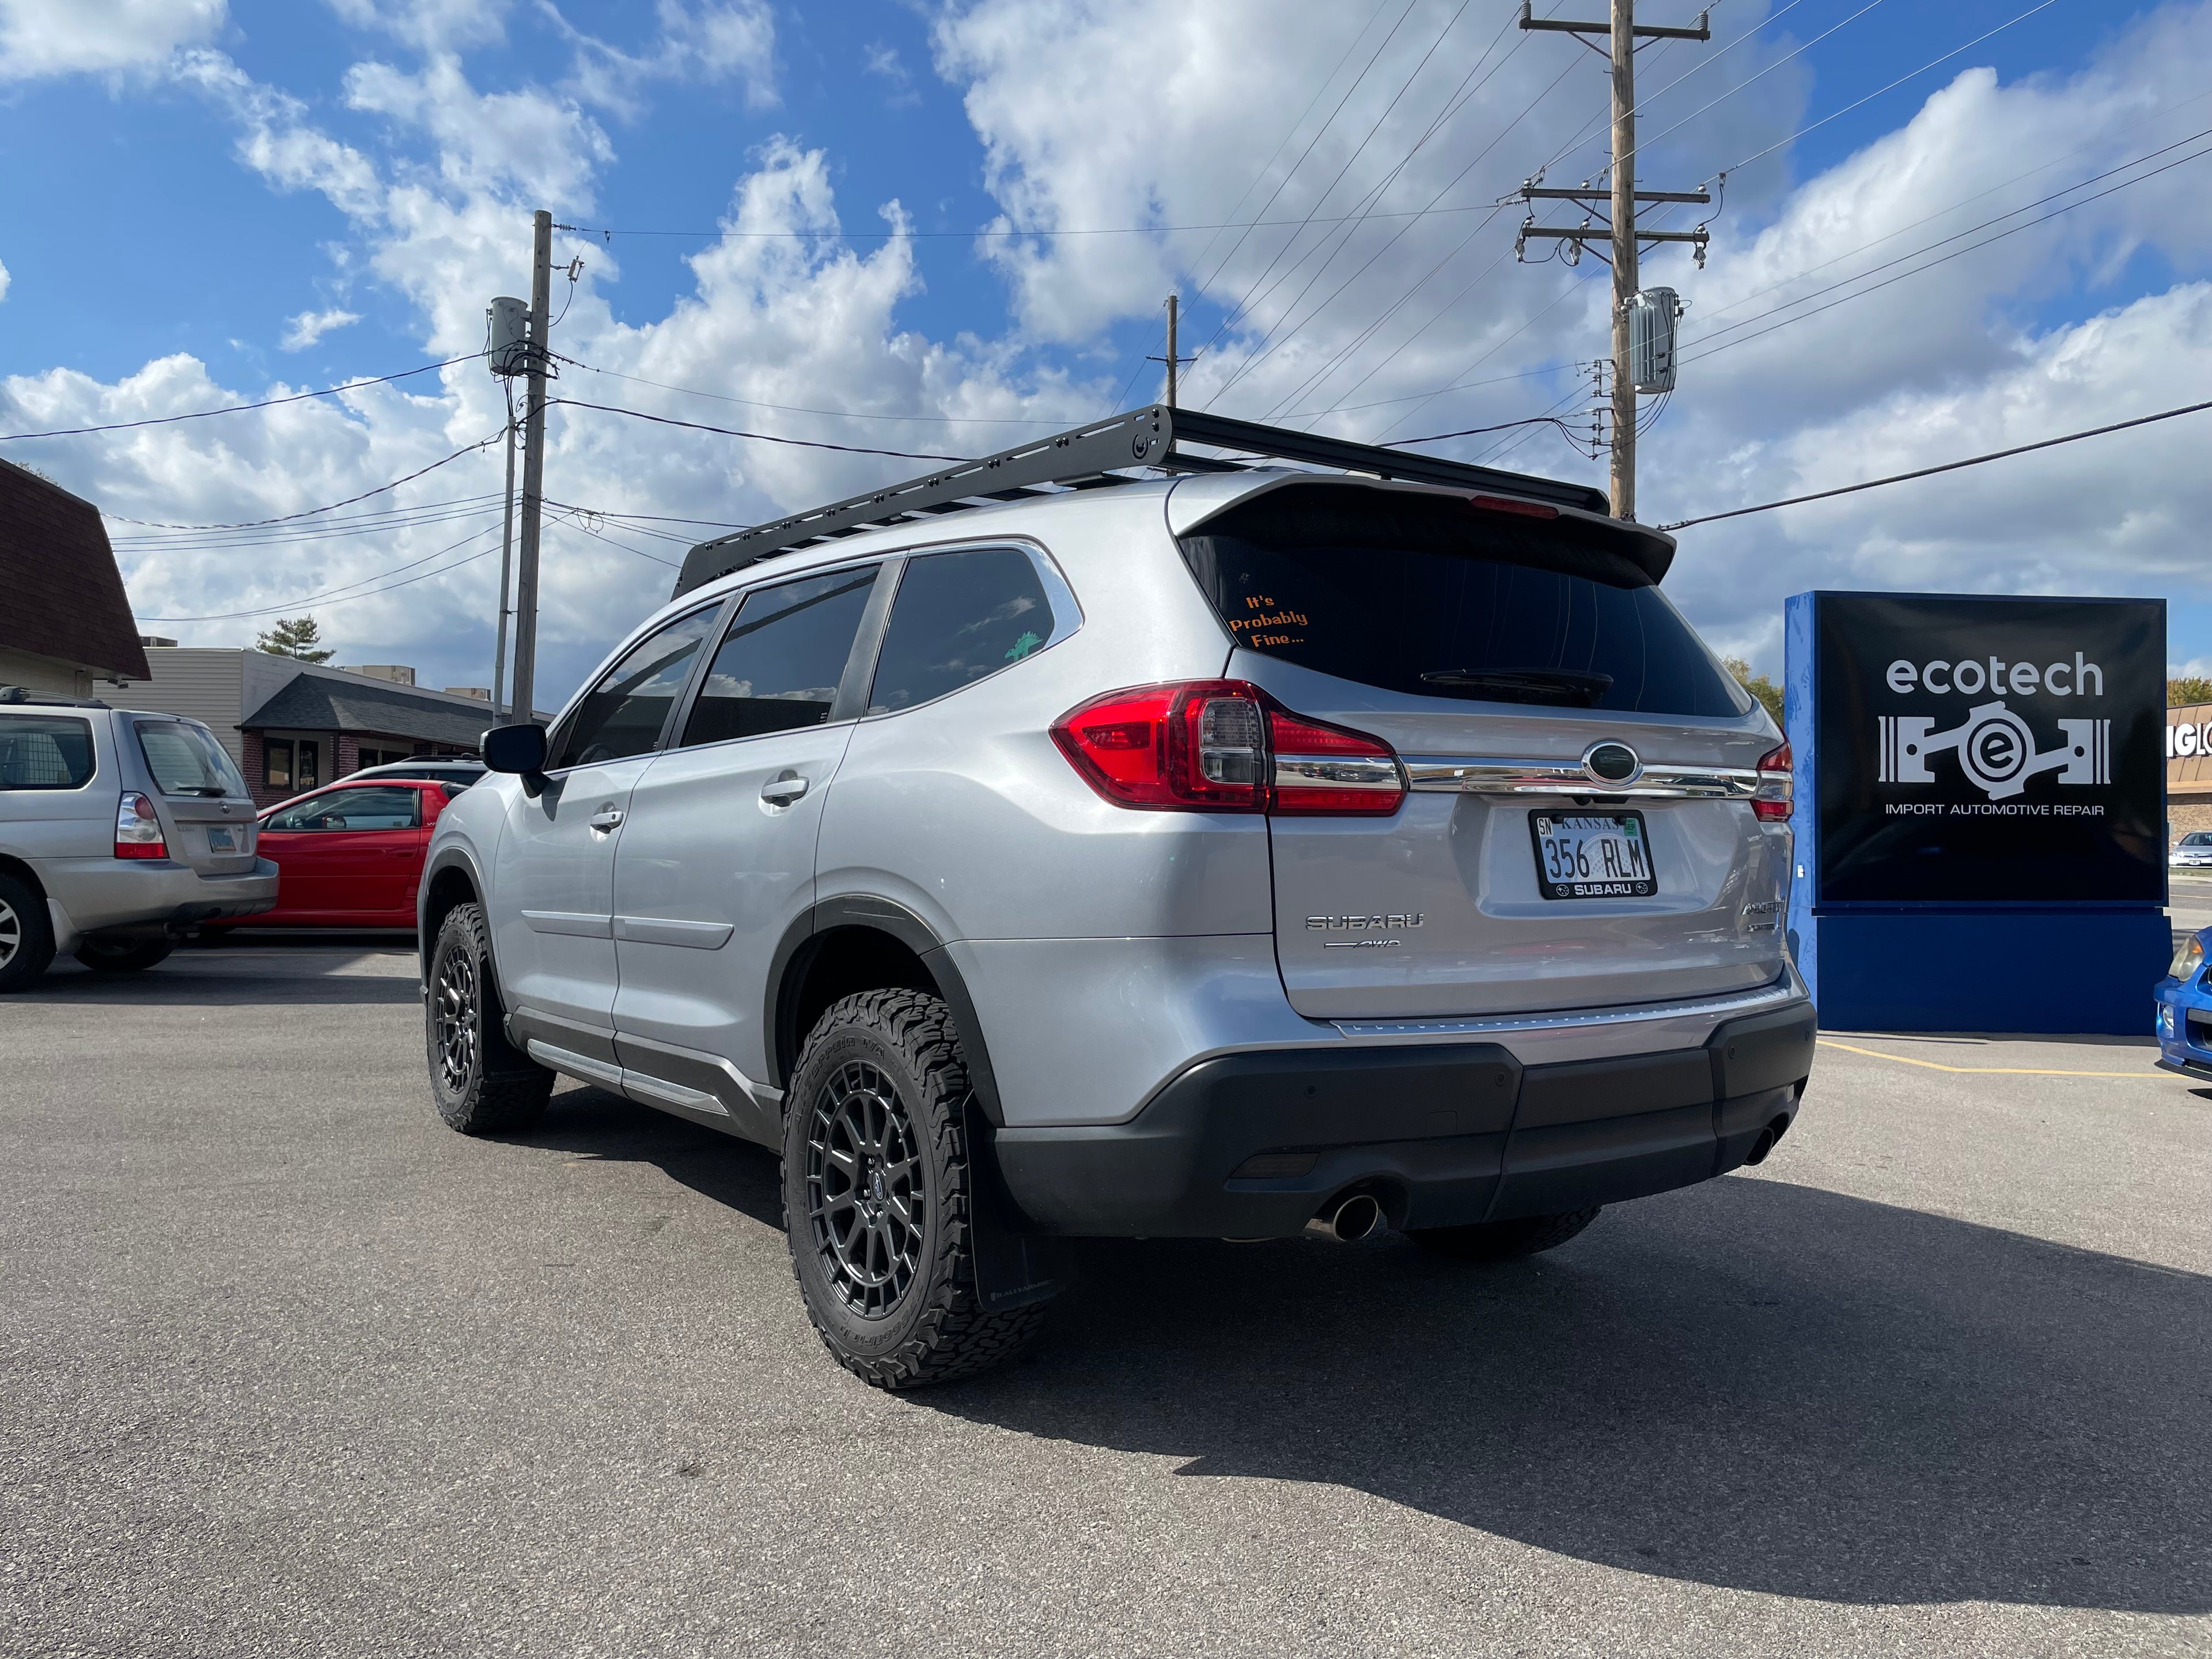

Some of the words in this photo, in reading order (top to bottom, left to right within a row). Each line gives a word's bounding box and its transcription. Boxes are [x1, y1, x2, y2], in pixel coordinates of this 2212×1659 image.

[1245, 595, 1274, 608] It's
[1229, 611, 1308, 631] Probably
[1251, 635, 1304, 647] Fine...
[1886, 652, 2103, 696] ecotech
[1885, 804, 1945, 815] IMPORT
[1950, 804, 2050, 815] AUTOMOTIVE
[2054, 805, 2104, 816] REPAIR
[1539, 819, 1552, 835] SN
[1562, 817, 1619, 830] KANSAS
[1545, 839, 1590, 878] 356
[1601, 839, 1645, 878] RLM
[1574, 883, 1632, 896] SUBARU
[1306, 913, 1425, 931] SUBARU
